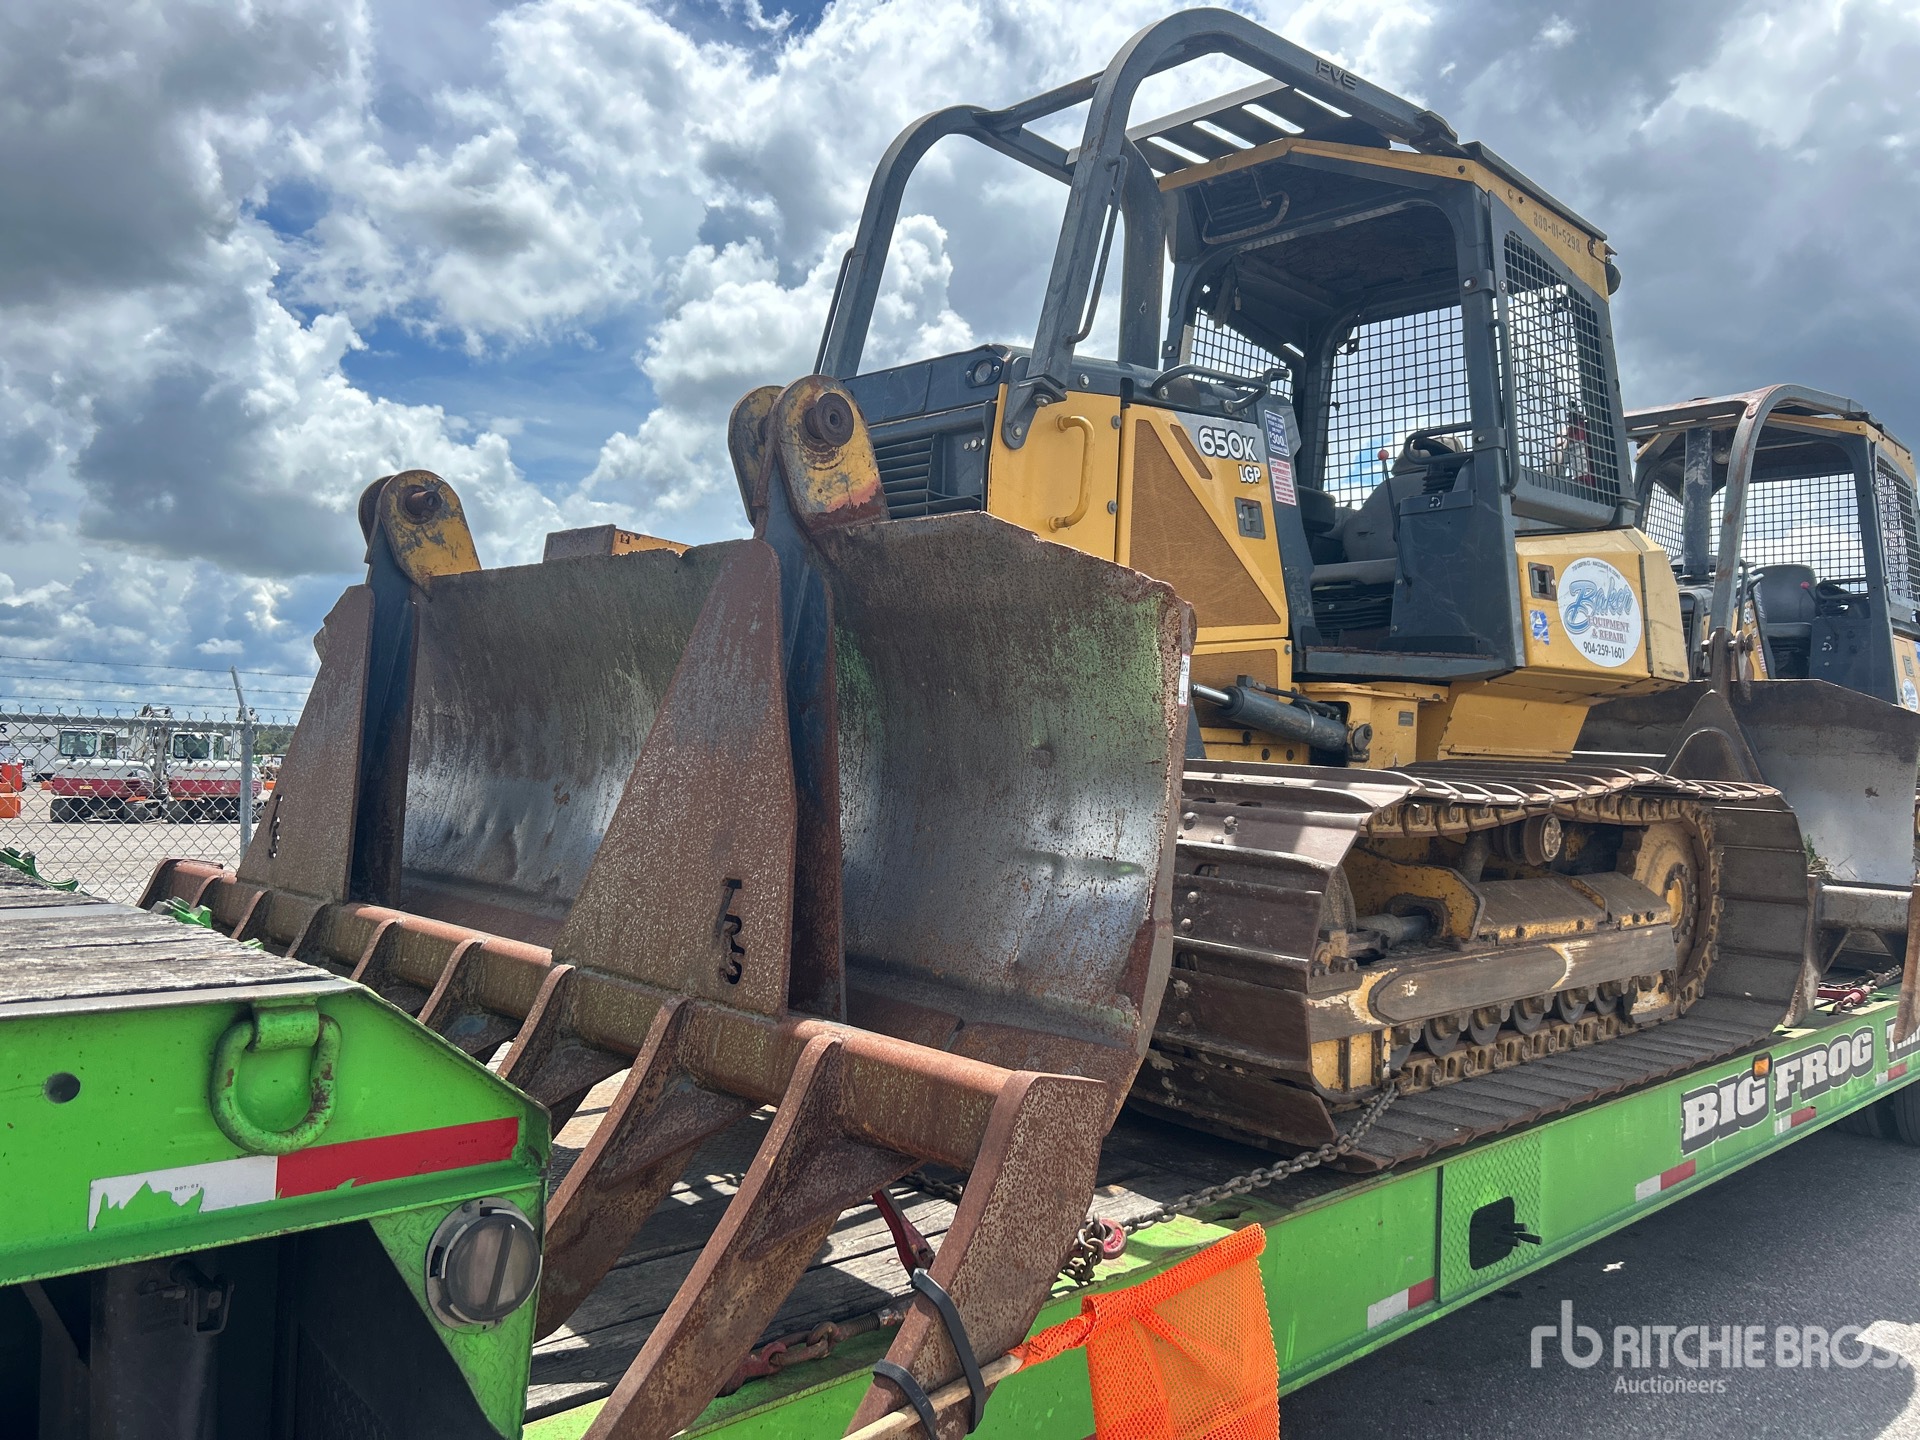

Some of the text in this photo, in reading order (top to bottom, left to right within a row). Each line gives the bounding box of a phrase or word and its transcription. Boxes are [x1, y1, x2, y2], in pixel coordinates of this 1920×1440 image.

[1198, 425, 1259, 462] 650K
[1239, 464, 1261, 484] LGP
[1564, 577, 1634, 635] Baker
[1588, 615, 1630, 633] EQUIPMENT
[1591, 628, 1626, 644] & REPAIR
[1583, 641, 1625, 659] 904-259-1601
[1682, 1073, 1768, 1147] BIG
[1774, 1028, 1873, 1106] FROG
